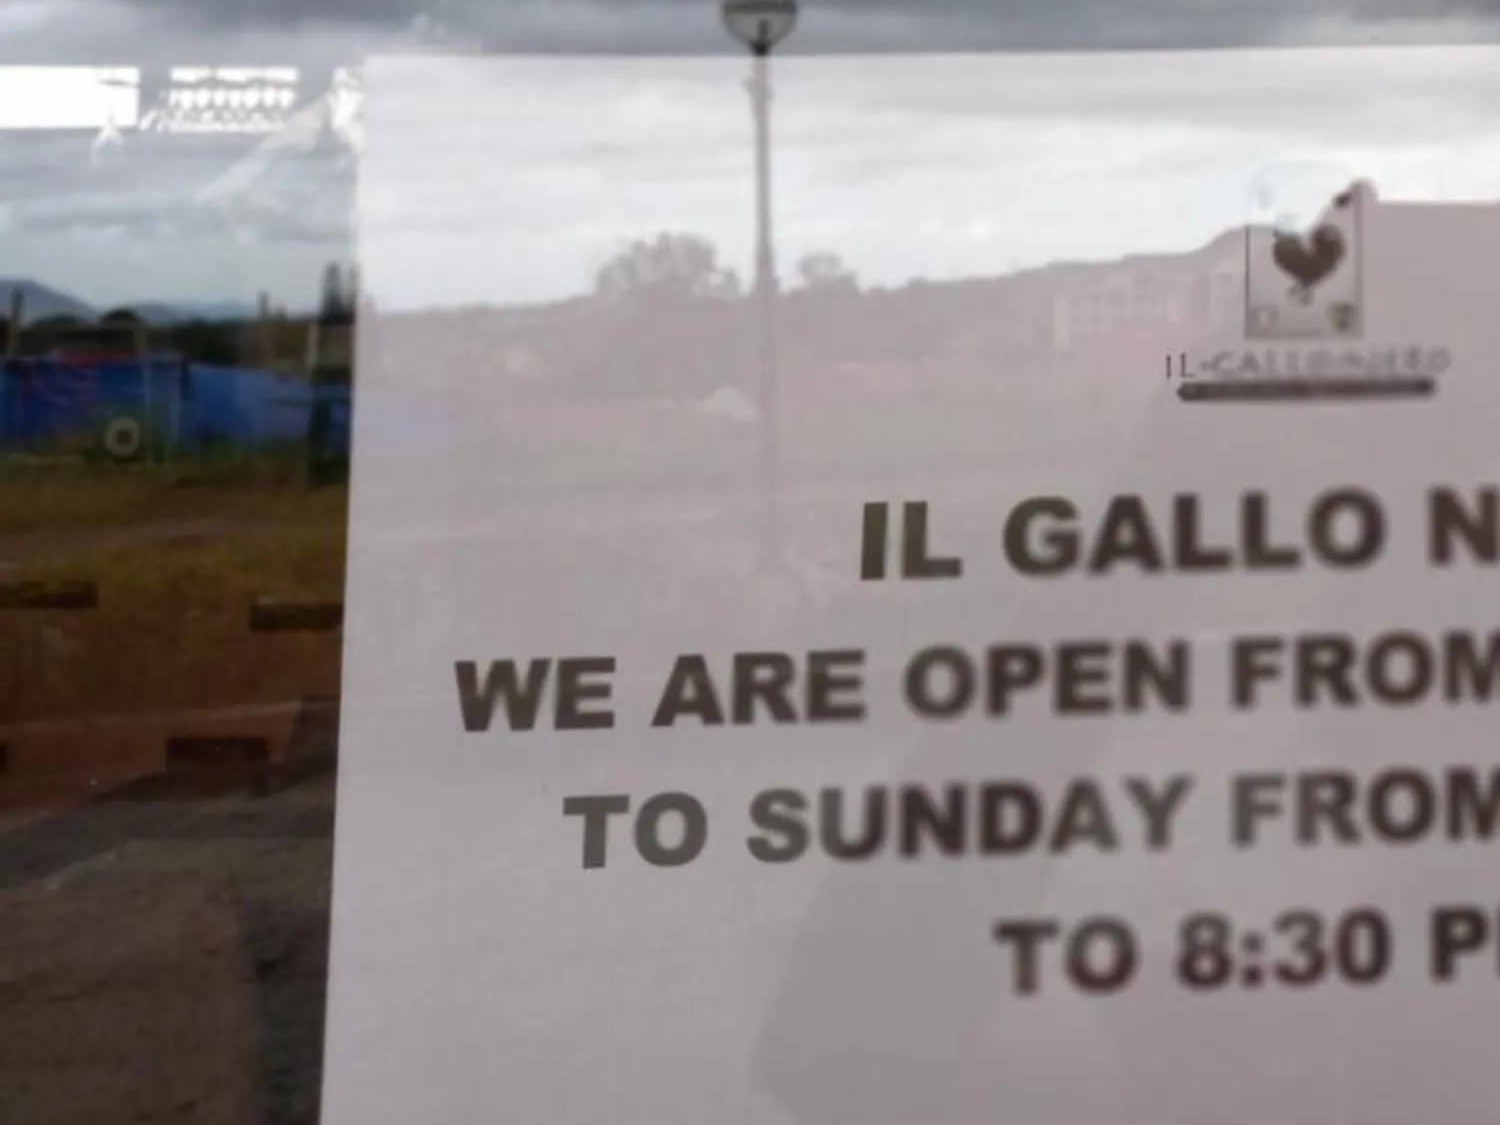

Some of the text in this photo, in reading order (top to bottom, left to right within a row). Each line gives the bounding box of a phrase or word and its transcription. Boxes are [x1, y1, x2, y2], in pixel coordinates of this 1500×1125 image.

[860, 501, 963, 581] IL
[1003, 487, 1387, 578] GALLO
[454, 656, 617, 732] WE
[651, 649, 867, 727] ARE
[904, 637, 1191, 721] OPEN
[562, 791, 709, 869] TO
[746, 773, 1193, 863] SUNDAY
[992, 914, 1140, 997] TO
[1176, 907, 1392, 991] 8:30
